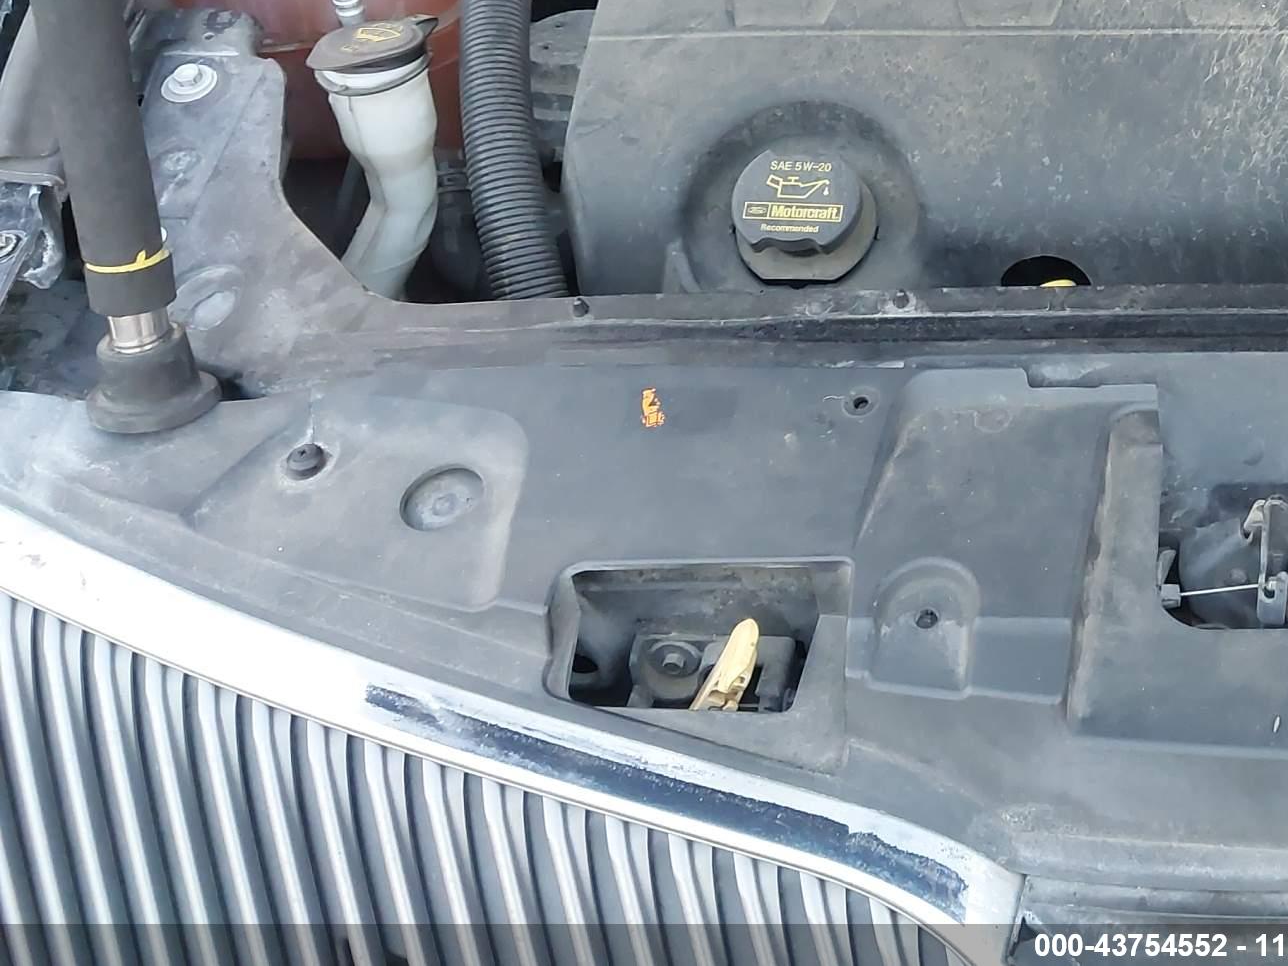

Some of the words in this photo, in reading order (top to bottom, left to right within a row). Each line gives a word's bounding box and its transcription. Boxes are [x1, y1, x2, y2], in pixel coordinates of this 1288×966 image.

[770, 160, 793, 171] SAE
[795, 162, 832, 172] 5W-20
[770, 204, 836, 219] Motorcraft
[761, 224, 819, 233] Recommended
